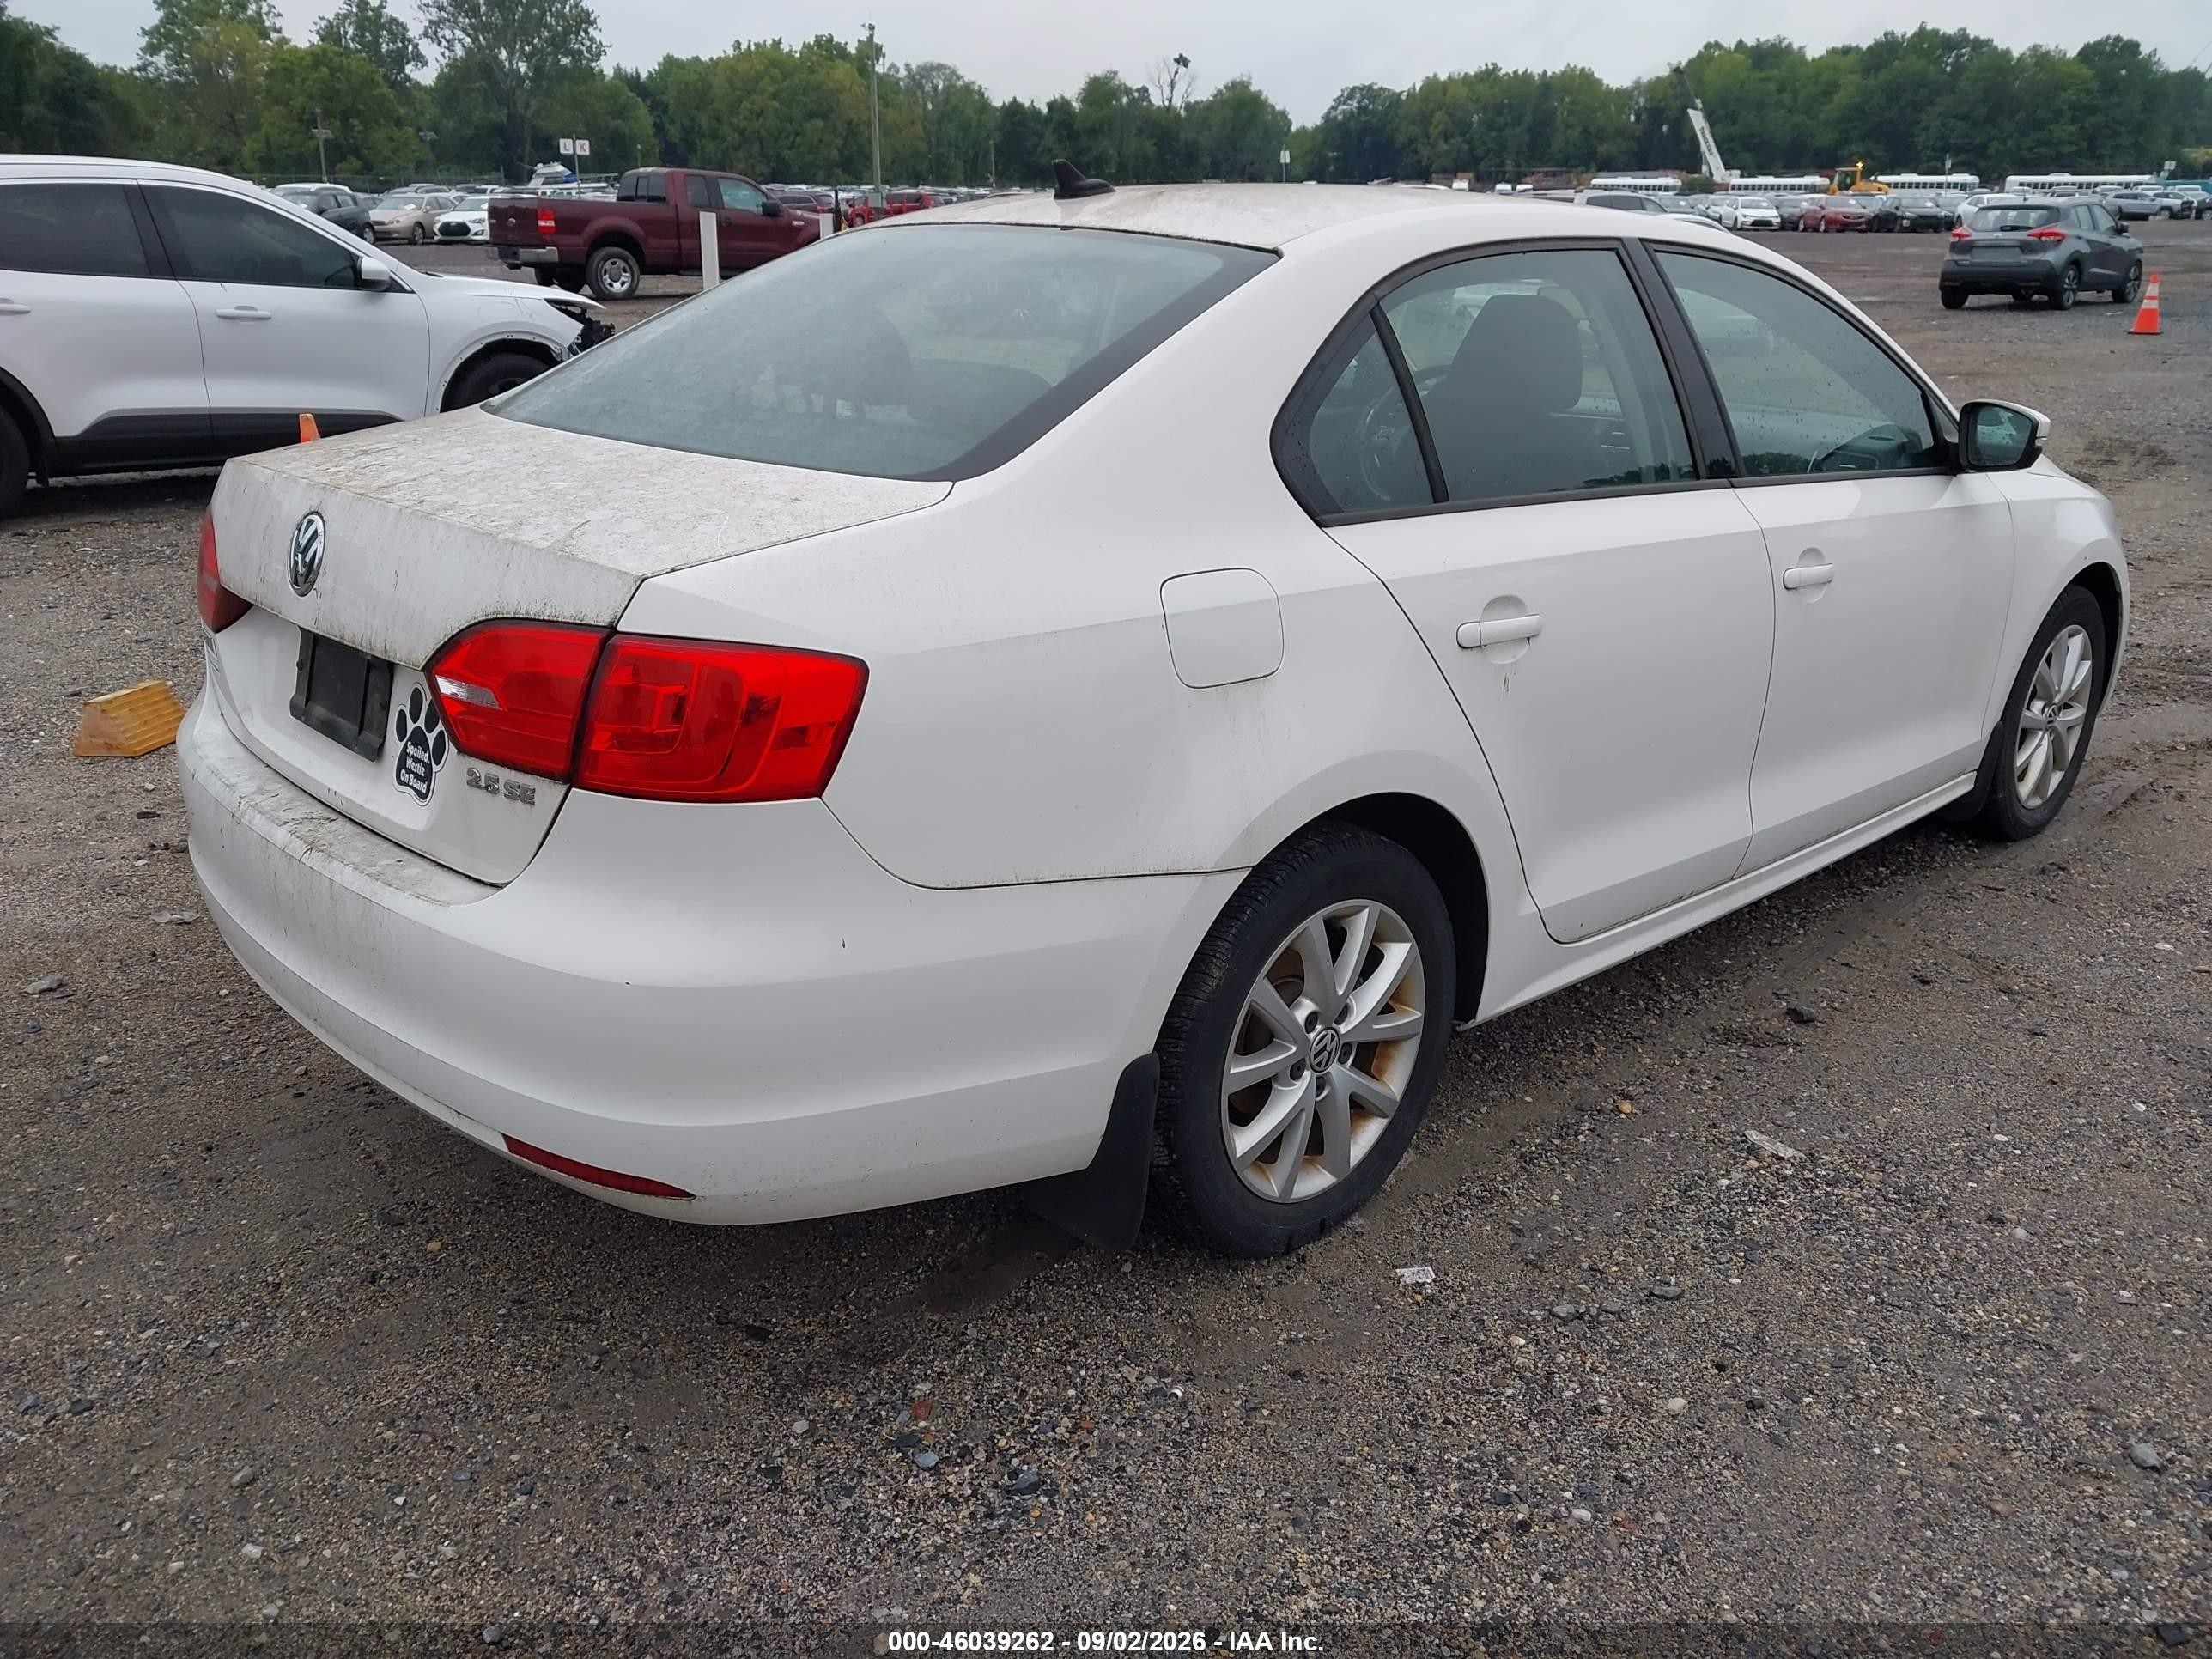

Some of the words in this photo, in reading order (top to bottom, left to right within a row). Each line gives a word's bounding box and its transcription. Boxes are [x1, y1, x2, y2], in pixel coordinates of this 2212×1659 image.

[406, 756, 425, 777] Westie
[400, 769, 410, 783] On
[409, 773, 428, 793] Board
[503, 778, 536, 806] SE
